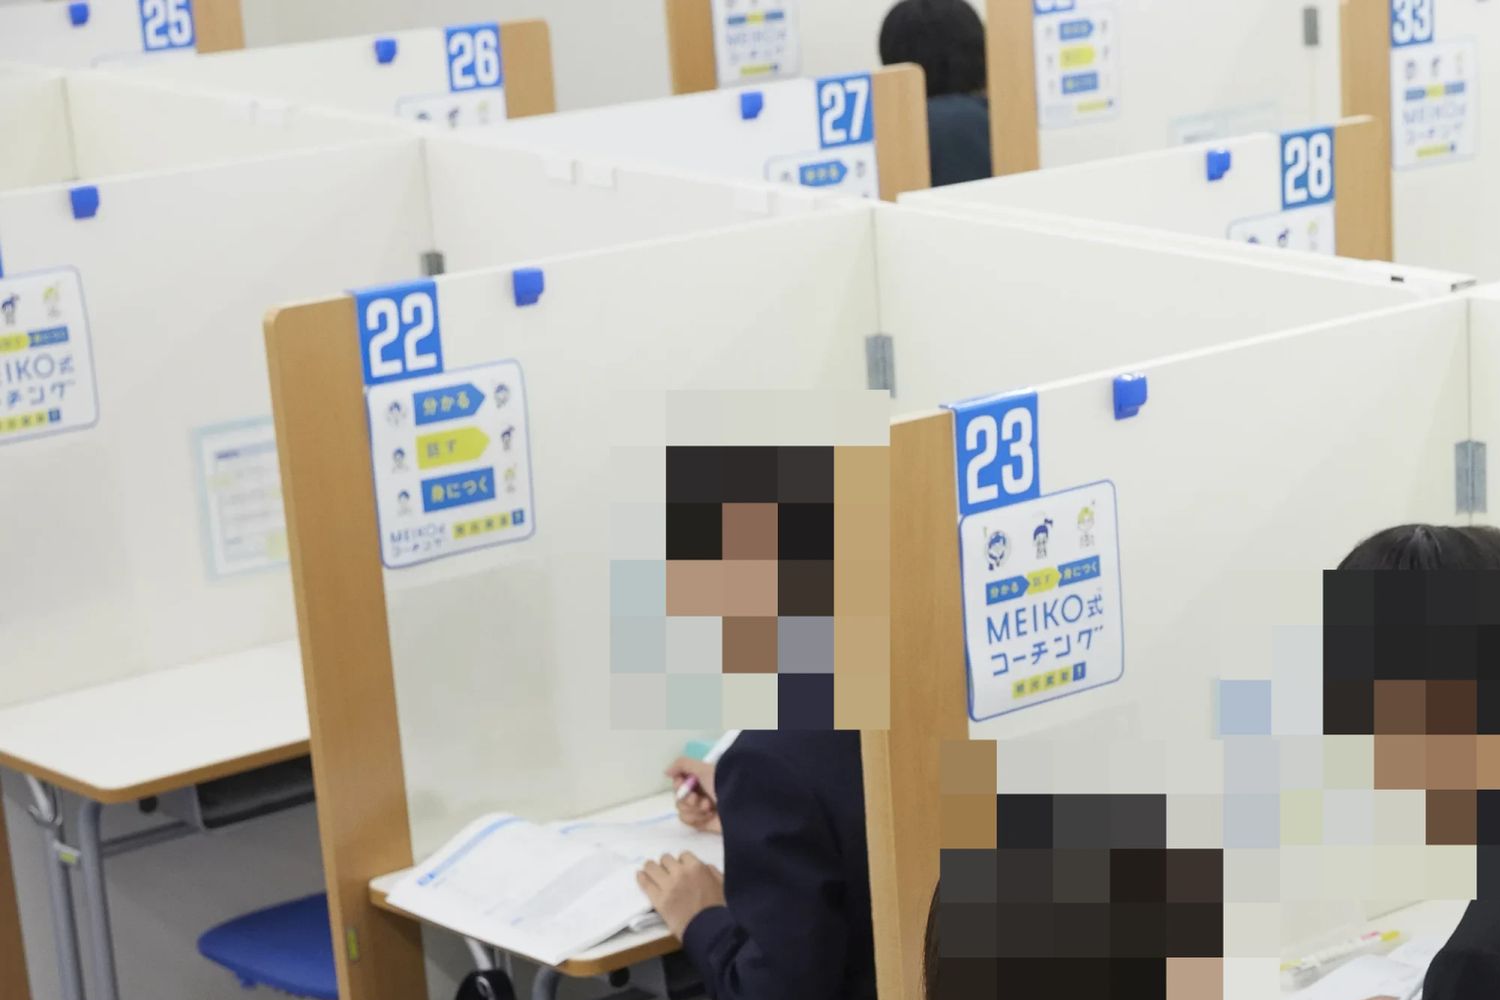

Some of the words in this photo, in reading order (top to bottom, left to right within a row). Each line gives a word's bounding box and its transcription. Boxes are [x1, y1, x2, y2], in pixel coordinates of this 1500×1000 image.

[143, 0, 191, 48] 25
[1392, 0, 1432, 44] 33
[449, 28, 500, 89] 26
[821, 79, 869, 144] 27
[1284, 132, 1331, 204] 28
[366, 292, 437, 378] 22
[965, 407, 1034, 505] 23
[986, 591, 1104, 645] MEIKO式
[990, 625, 1104, 677] コーチング
